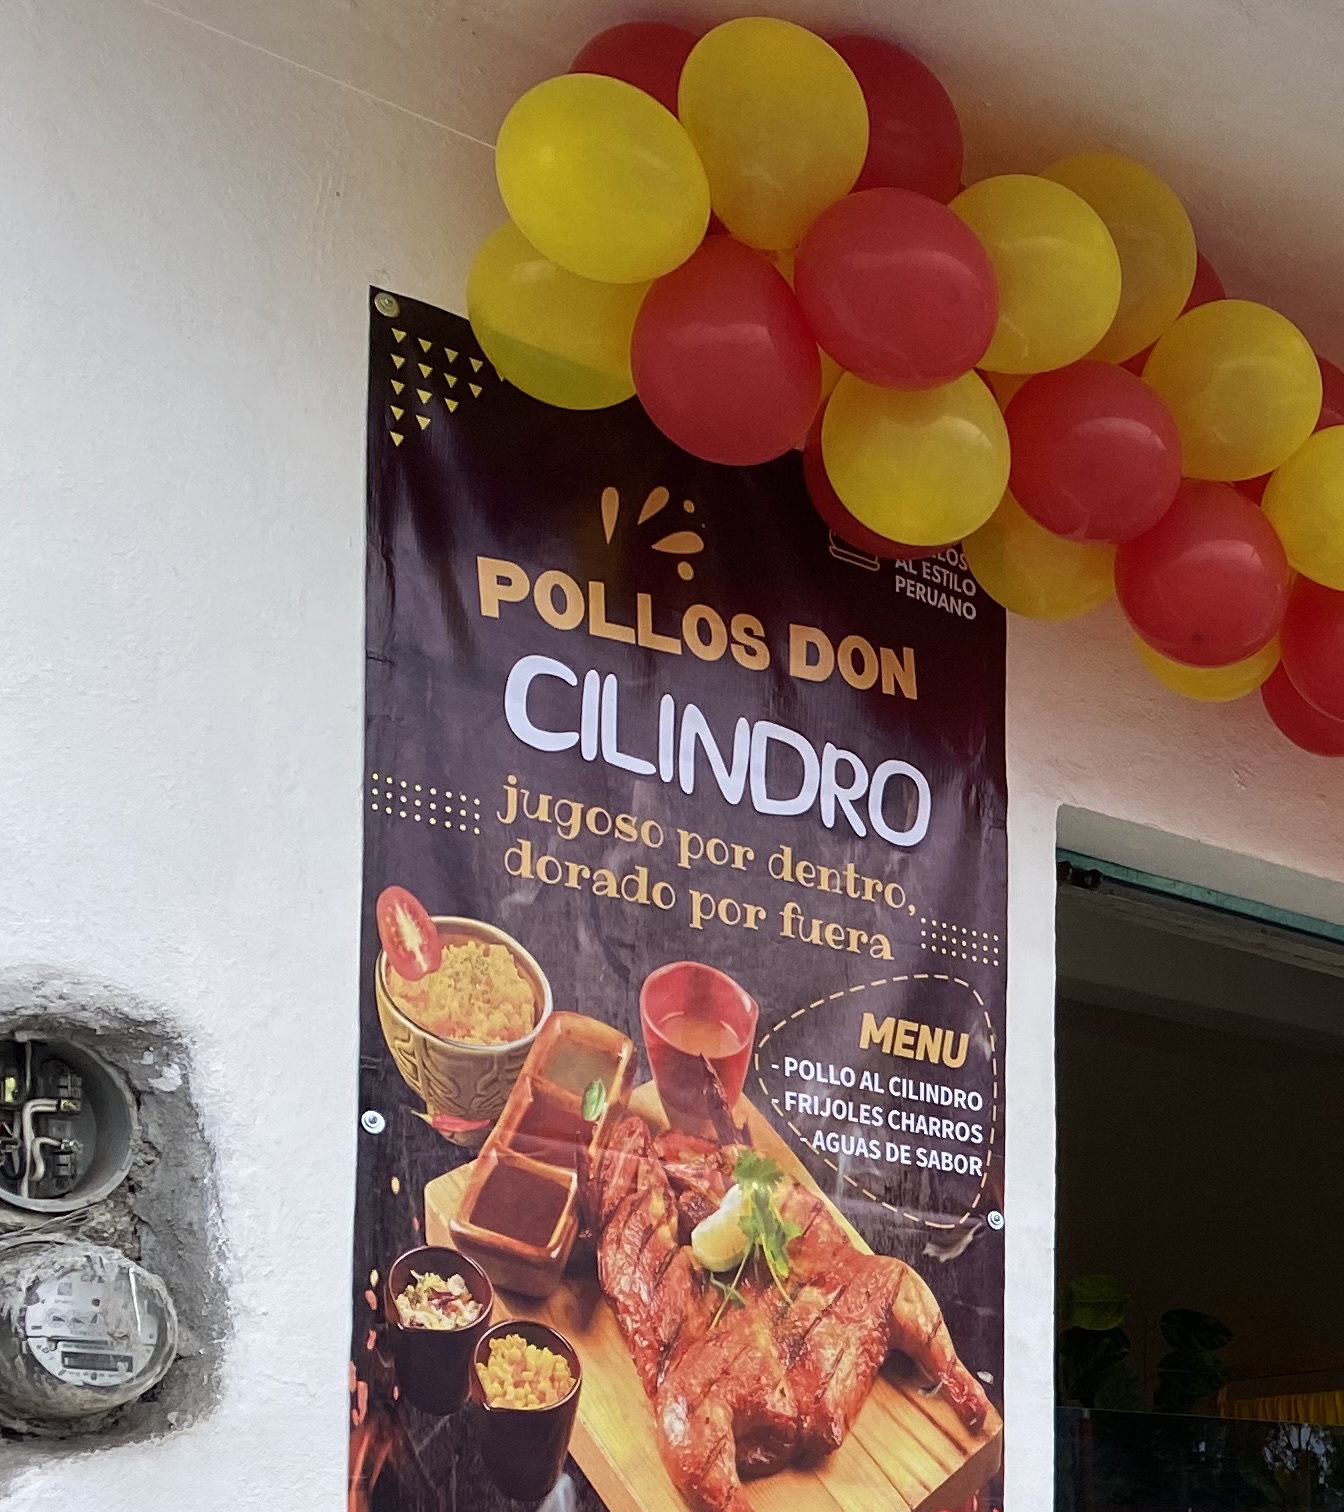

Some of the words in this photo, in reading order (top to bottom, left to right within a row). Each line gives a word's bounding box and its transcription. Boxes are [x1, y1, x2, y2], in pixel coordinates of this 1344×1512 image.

[895, 559, 917, 575] AL
[922, 561, 976, 597] ESTILO
[895, 575, 977, 620] PERUANO
[477, 555, 770, 671] POLLOS
[789, 624, 918, 700] DON
[504, 654, 931, 847] CILINDRO
[497, 775, 665, 849] jugoso
[676, 827, 755, 877] por
[768, 844, 918, 917] dentro,
[504, 839, 676, 910] dorado
[689, 888, 766, 936] por
[779, 905, 894, 961] fuera
[859, 1012, 969, 1068] MENU
[784, 1057, 856, 1089] POLLO
[859, 1068, 885, 1093] AL
[888, 1072, 984, 1113] CILINDRO
[784, 1091, 884, 1127] FRIJOLES
[887, 1109, 984, 1144] CHARROS
[812, 1131, 880, 1160] AGUAS
[885, 1141, 912, 1166] DE
[915, 1145, 983, 1176] SABOR
